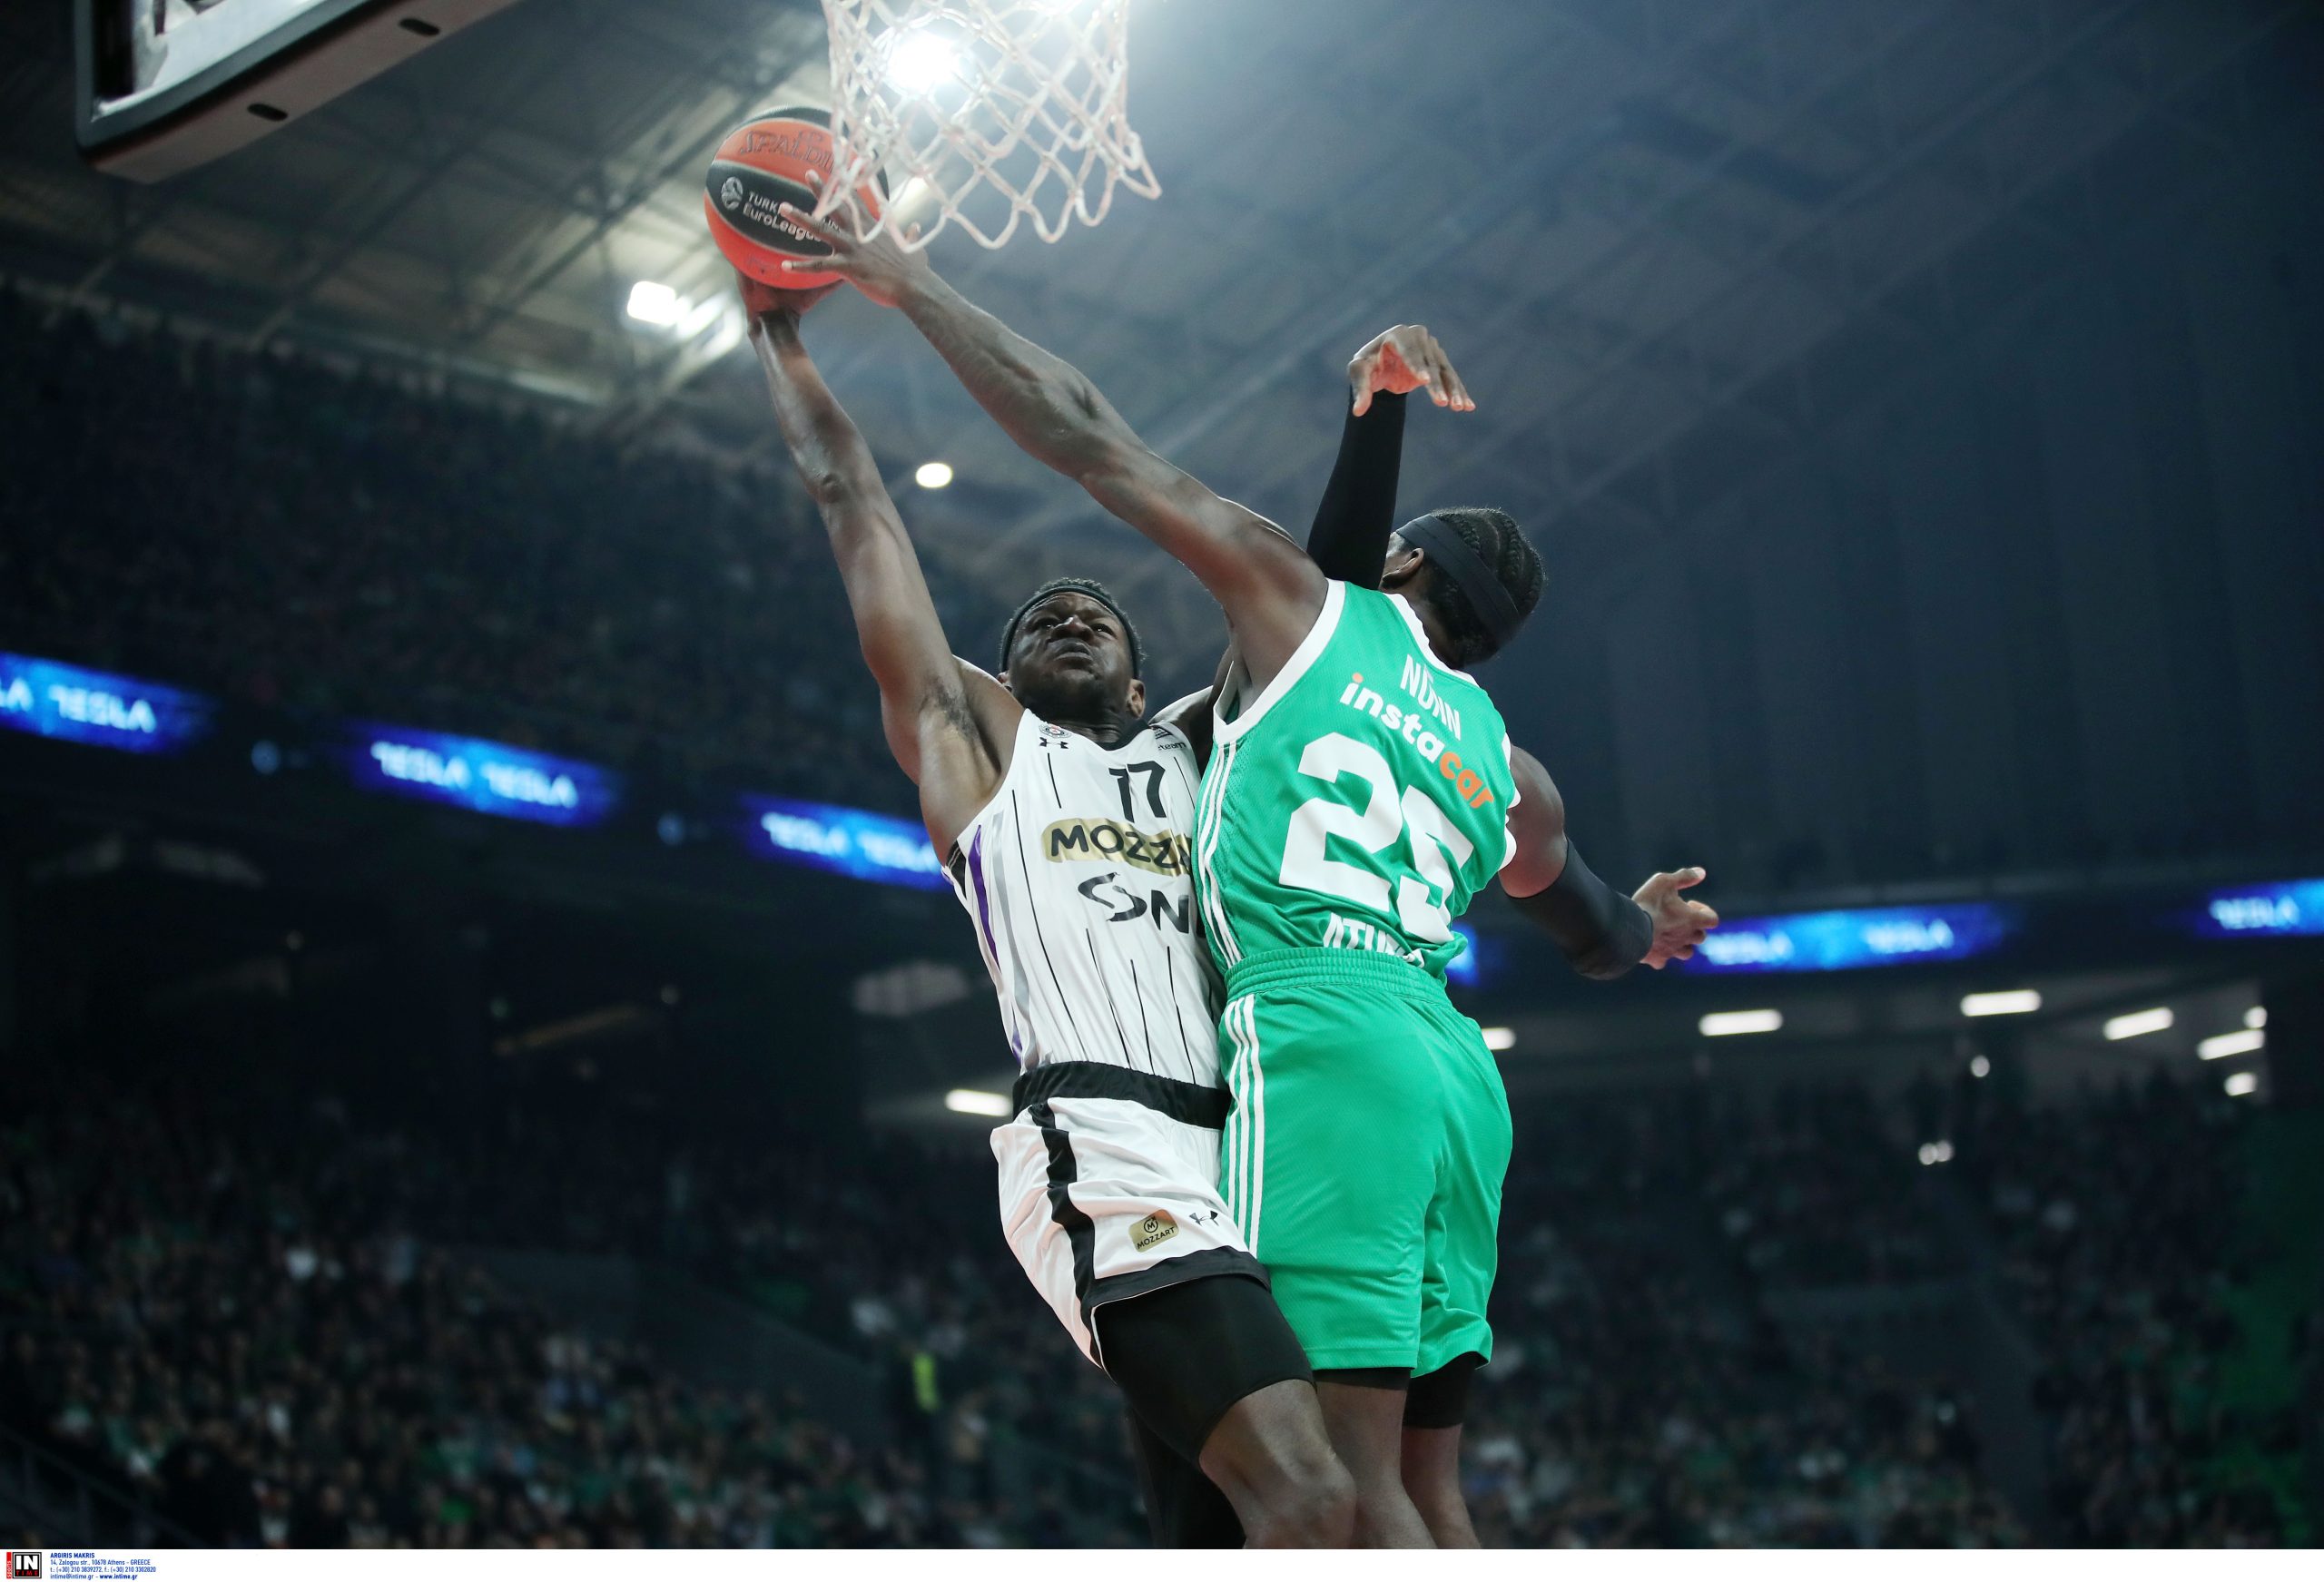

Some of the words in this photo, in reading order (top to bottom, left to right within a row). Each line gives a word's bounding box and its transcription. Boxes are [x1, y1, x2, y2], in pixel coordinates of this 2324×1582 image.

[1400, 653, 1462, 741] NUNN
[1339, 673, 1494, 809] instacar
[1108, 761, 1167, 822] 17
[1050, 824, 1191, 869] MOZZ
[1278, 732, 1474, 944] 25
[1137, 1226, 1176, 1250] MOZZART
